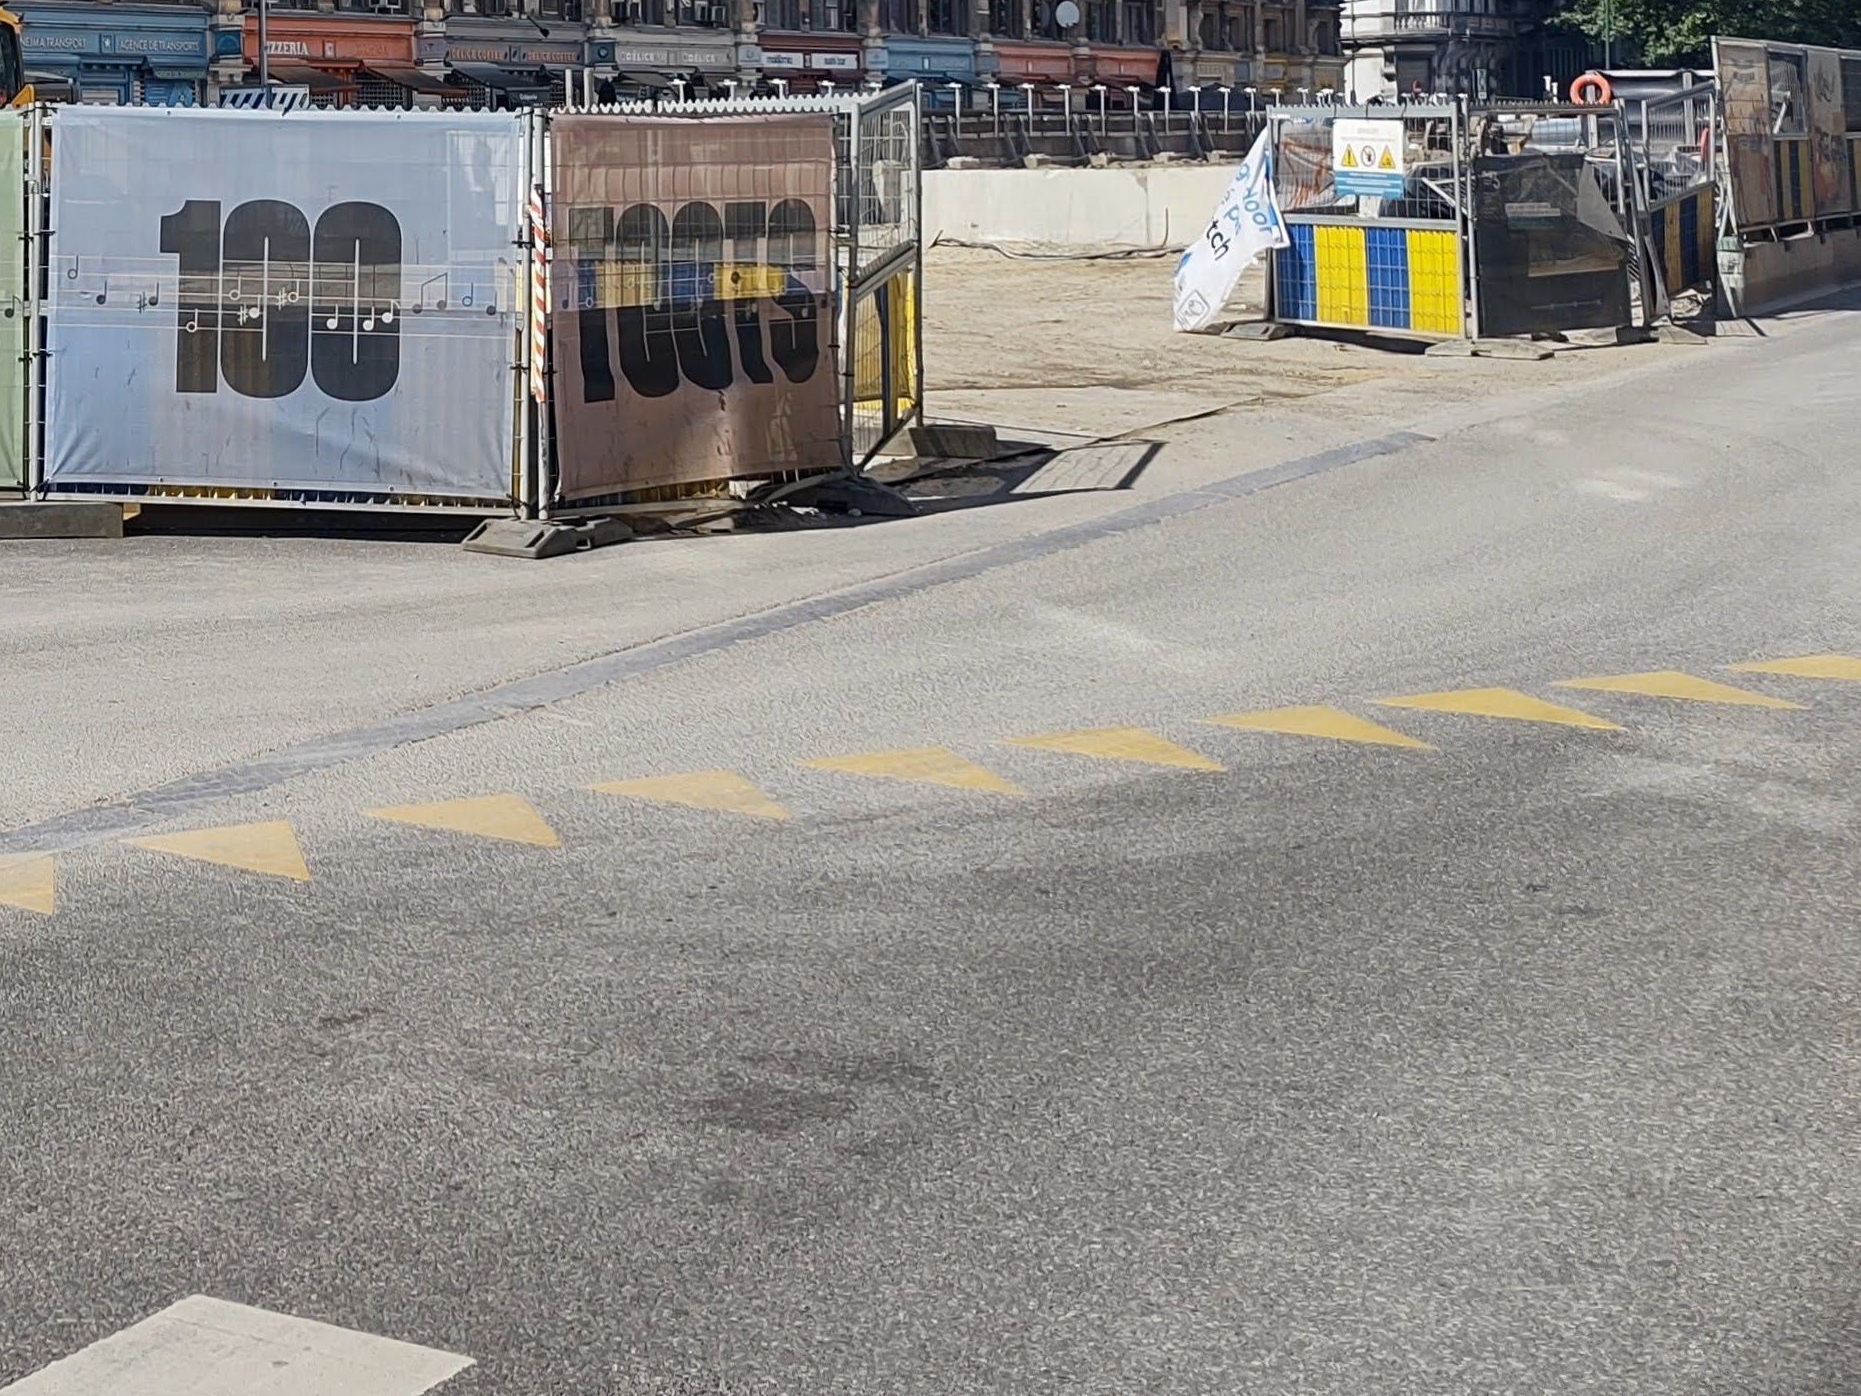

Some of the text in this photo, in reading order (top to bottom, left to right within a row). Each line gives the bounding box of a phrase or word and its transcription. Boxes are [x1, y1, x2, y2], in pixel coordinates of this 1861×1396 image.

[46, 36, 87, 49] TRANSPORT
[265, 41, 309, 56] IZZERIA
[159, 198, 403, 402] 100
[568, 198, 820, 404] TOOTS
